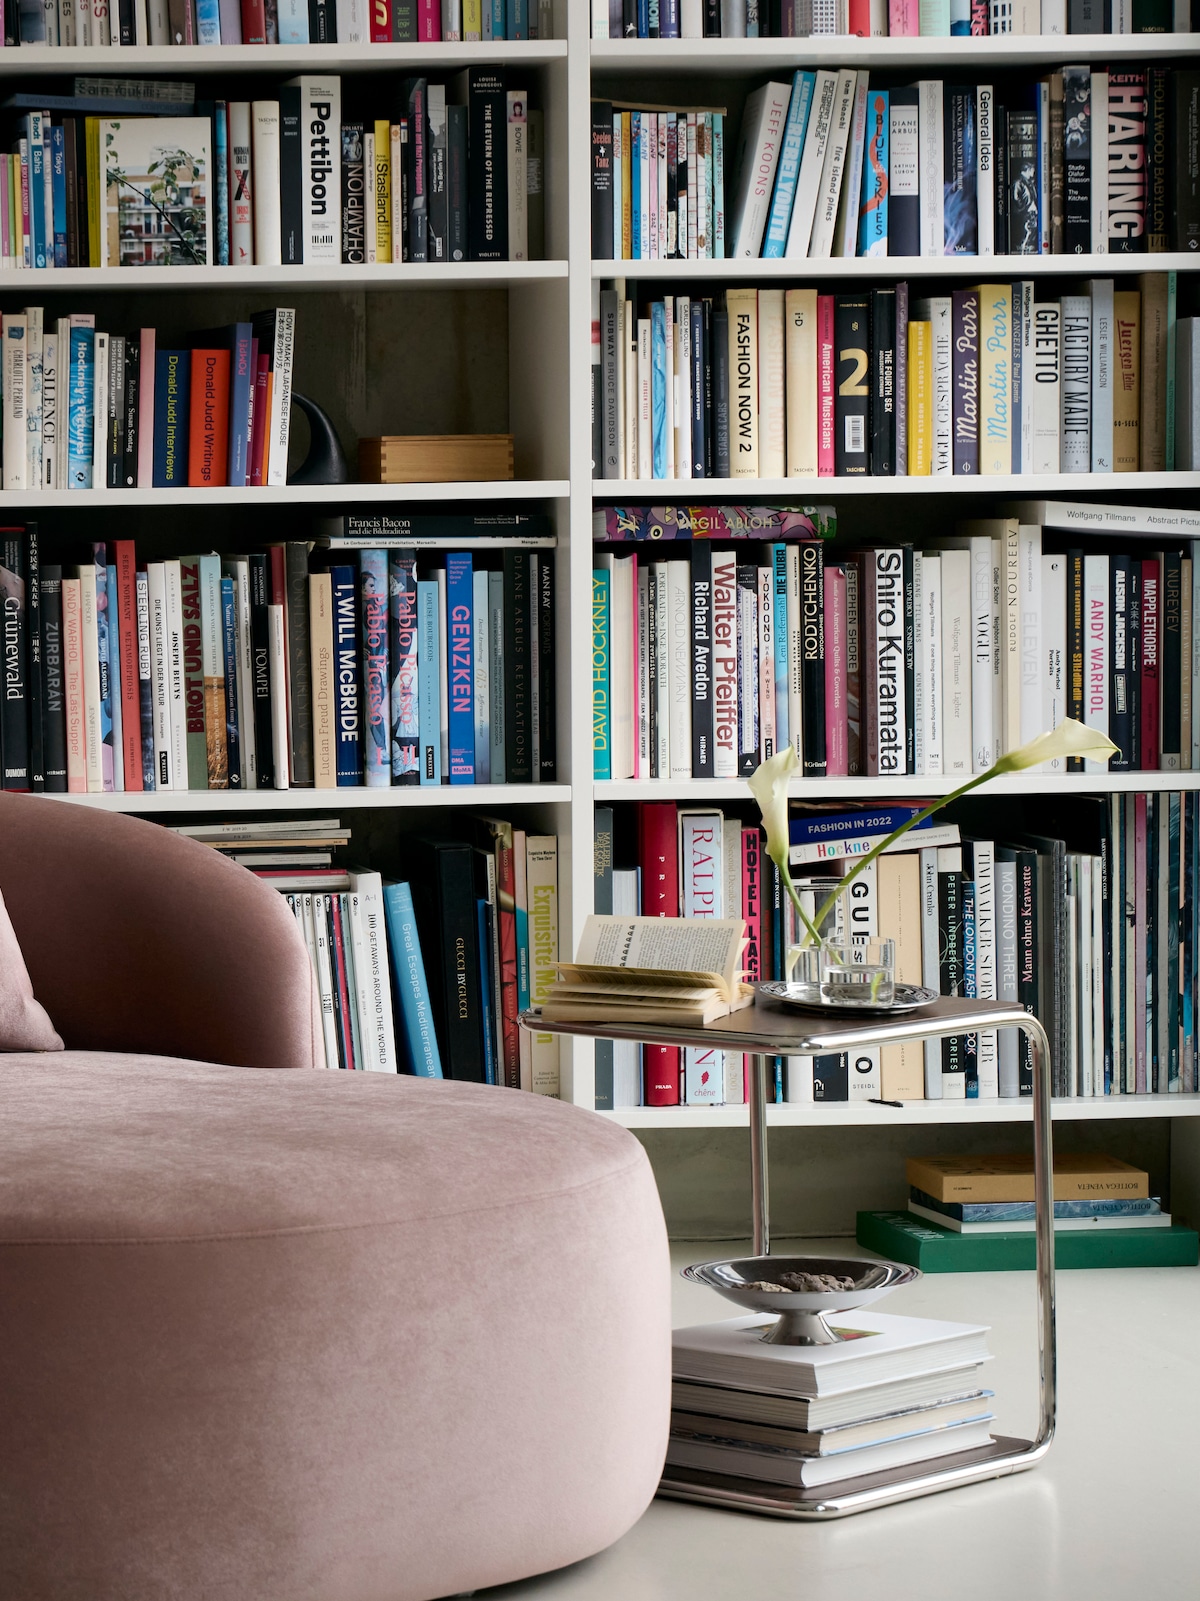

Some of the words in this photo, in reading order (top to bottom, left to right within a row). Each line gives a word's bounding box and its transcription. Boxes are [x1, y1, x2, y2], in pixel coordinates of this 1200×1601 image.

[32, 116, 41, 140] Bradt
[484, 104, 493, 121] THE
[768, 100, 783, 135] JEFF
[980, 90, 991, 140] General
[1154, 78, 1165, 163] HOLLYWOOD
[34, 150, 43, 174] Bahia
[55, 151, 64, 174] Tokyo
[310, 102, 332, 215] Pettibon
[484, 122, 493, 157] RETURN
[981, 143, 991, 171] Idea
[1108, 86, 1145, 238] HARING
[484, 160, 494, 172] OF
[485, 173, 494, 189] THE
[755, 142, 775, 197] KOONS
[348, 164, 363, 263] CHAMPION
[376, 163, 389, 223] Stasiland
[485, 193, 495, 241] REPRESSED
[1154, 166, 1165, 231] BABYLON
[275, 311, 285, 369] 日本の家の作り方
[955, 297, 977, 352] Parr
[986, 297, 1007, 352] Parr
[1035, 309, 1058, 384] GHETTO
[1064, 316, 1088, 384] FACTORY
[74, 342, 87, 403] Hockney's
[168, 355, 179, 394] Donald
[737, 314, 750, 388] FASHION
[822, 343, 832, 392] American
[839, 348, 869, 396] 2
[884, 349, 892, 364] THE
[205, 357, 217, 398] Donald
[884, 365, 892, 396] FOURTH
[934, 334, 950, 424] GESPRÄCHE
[957, 359, 978, 438] Martin
[987, 359, 1008, 438] Martin
[43, 368, 56, 444] SILENCE
[167, 396, 178, 423] Judd
[204, 401, 216, 431] Judd
[738, 395, 751, 438] NOW
[822, 395, 833, 449] Musicians
[884, 397, 892, 412] SEX
[1064, 392, 1088, 435] MADE
[76, 406, 86, 455] Pictures
[166, 425, 177, 480] Interviews
[740, 443, 752, 453] 2
[937, 429, 950, 471] VOGUE
[201, 433, 215, 481] Writings
[1066, 510, 1103, 522] Wolfgang
[1104, 512, 1137, 524] Tillmans
[1146, 515, 1179, 526] Abstract
[67, 586, 79, 616] ANDY
[138, 582, 149, 641] STERLING
[181, 564, 200, 620] SALZ
[694, 581, 709, 640] Richard
[714, 562, 736, 649] Walter
[803, 548, 818, 660] RODTCHENKO
[848, 572, 858, 624] STEPHEN
[877, 552, 902, 627] Shiro
[1166, 568, 1179, 633] NUREYEV
[68, 618, 80, 664] WARHOL
[367, 592, 386, 648] Pablo
[397, 590, 417, 646] Pablo
[592, 580, 607, 681] HOCKNEY
[977, 613, 990, 664] VOGUE
[1090, 599, 1104, 642] ANDY
[4, 597, 24, 701] Grünewald
[45, 622, 64, 712] ZURBARÁN
[139, 645, 149, 677] RUBY
[185, 624, 203, 673] UND
[256, 648, 268, 697] POMPEI
[452, 604, 471, 713] GENZKEN
[695, 645, 710, 700] Avedon
[848, 629, 858, 670] SHORE
[1023, 611, 1038, 686] ELEVEN
[69, 671, 80, 690] The
[70, 692, 80, 715] Last
[187, 678, 204, 733] BROT
[339, 650, 358, 742] McBRIDE
[368, 654, 388, 725] Picasso
[398, 652, 417, 724] Picasso
[716, 657, 737, 751] Pfeiffer
[878, 635, 903, 771] Kuramata
[1090, 647, 1104, 715] WARHOL
[69, 717, 81, 756] Supper
[592, 689, 607, 750] DAVID
[699, 736, 707, 765] HIRMER
[808, 821, 852, 834] FASHION
[854, 819, 865, 828] IN
[867, 816, 892, 827] 2022
[1001, 870, 1014, 939] MONDINO
[1021, 866, 1034, 917] Krawatte
[402, 923, 413, 952] Great
[529, 885, 556, 966] Exquisite
[1022, 919, 1034, 948] ohne
[406, 955, 422, 998] Escapes
[455, 937, 466, 971] GUCCI
[457, 973, 467, 986] BY
[1002, 945, 1015, 990] THREE
[1022, 949, 1033, 983] Mann
[458, 986, 469, 1020] GUCCI
[415, 1001, 436, 1078] Mediterranean
[1107, 1182, 1139, 1190] BOTTEGA
